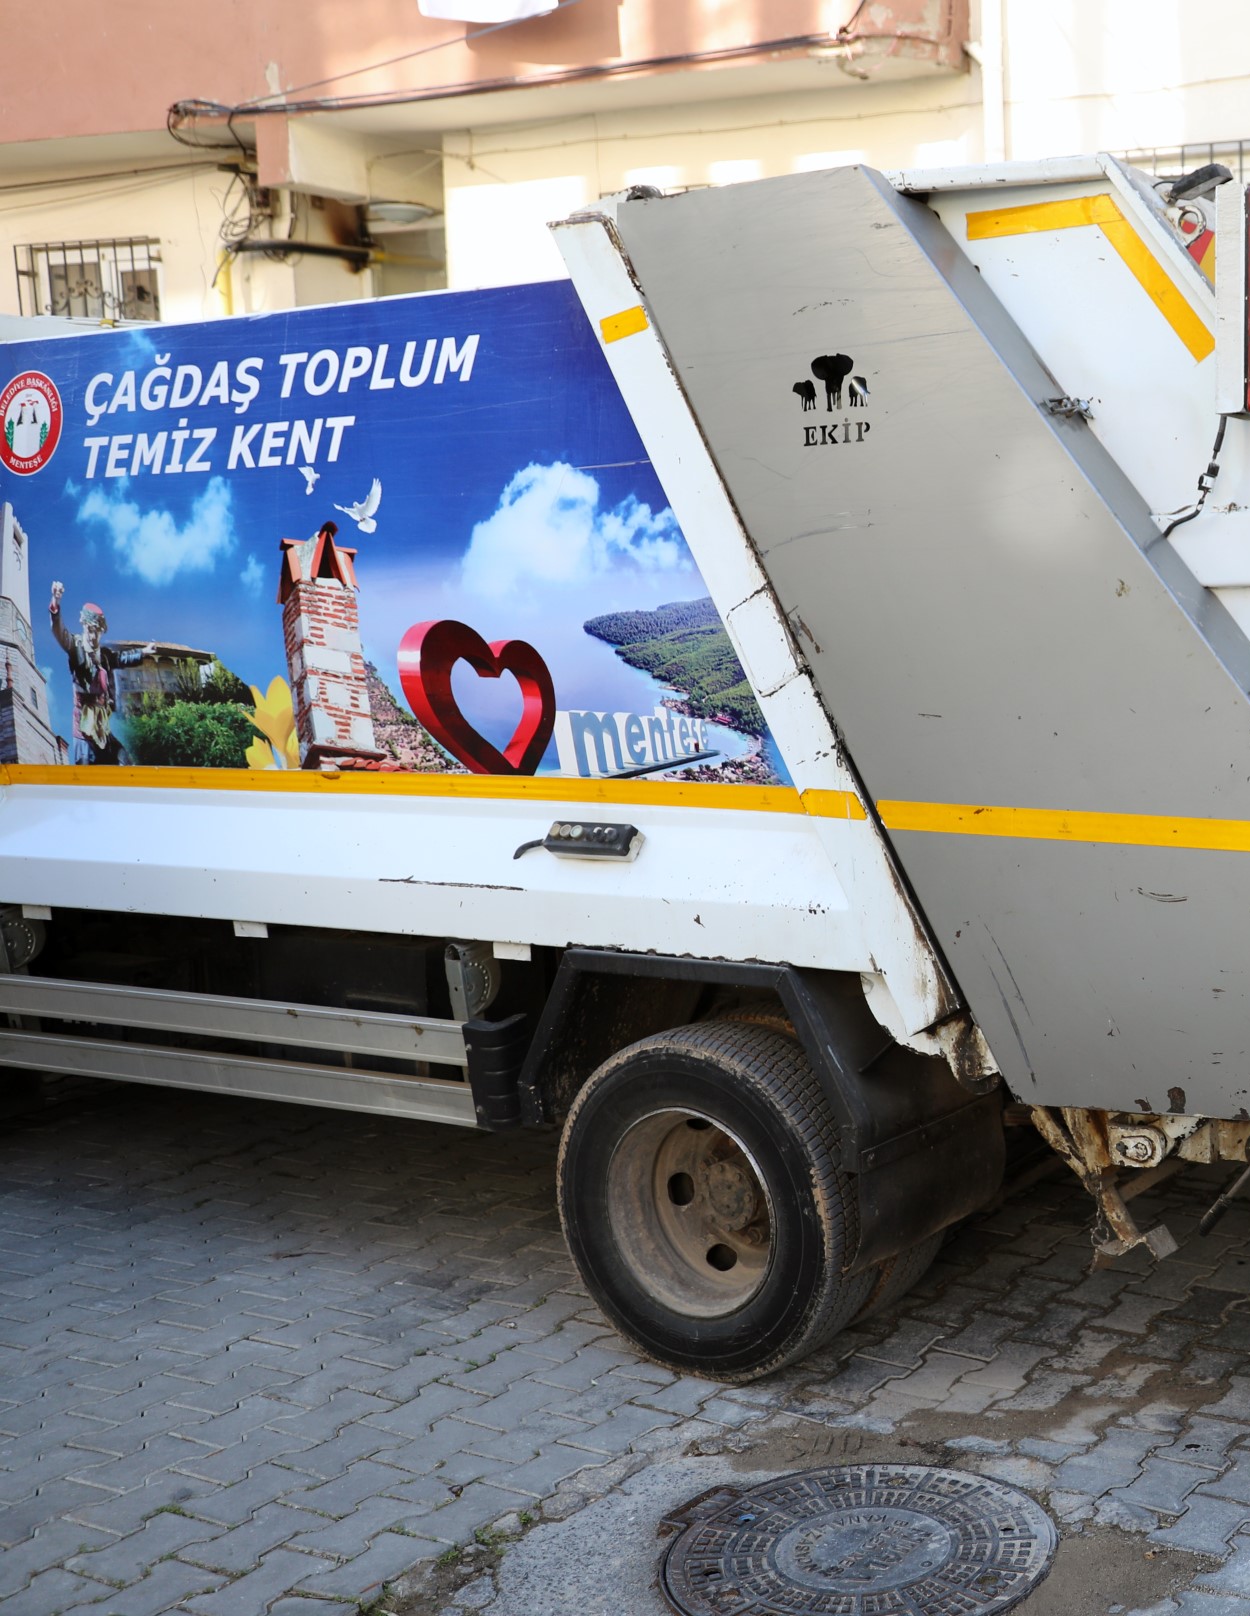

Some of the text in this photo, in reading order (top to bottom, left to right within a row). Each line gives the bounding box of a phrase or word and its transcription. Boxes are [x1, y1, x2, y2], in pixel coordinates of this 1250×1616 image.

[84, 334, 480, 426] ÇAĞDAŞ TOPLUM
[83, 416, 355, 479] TEMİZ KENT
[803, 417, 871, 447] EKİP
[9, 454, 43, 470] MENTEŞE
